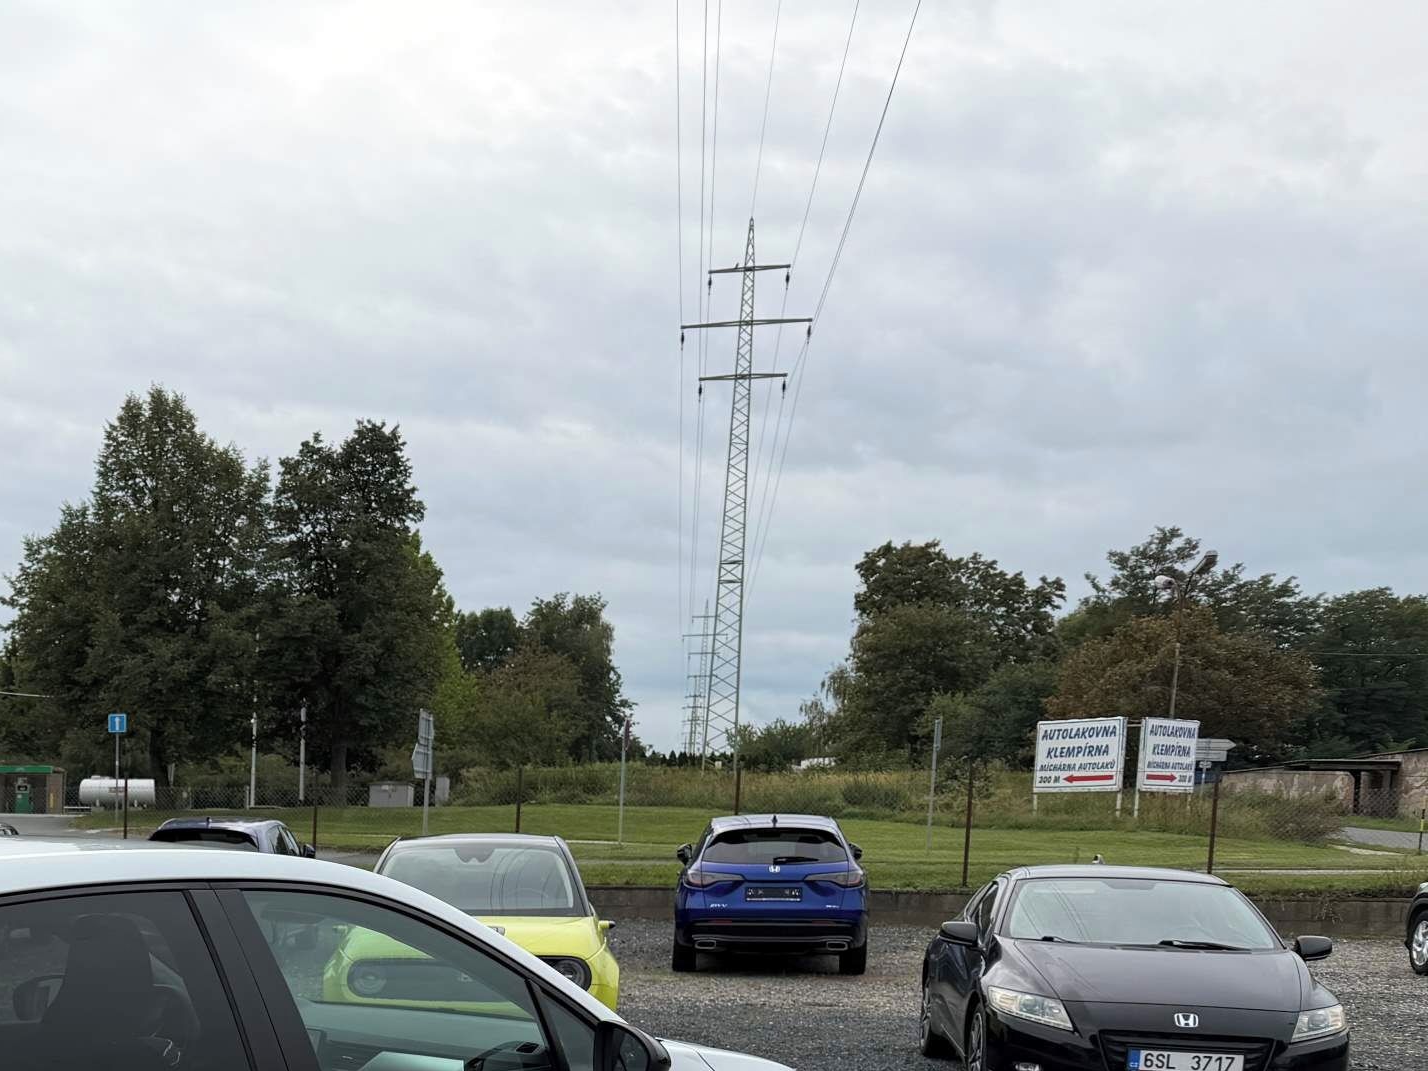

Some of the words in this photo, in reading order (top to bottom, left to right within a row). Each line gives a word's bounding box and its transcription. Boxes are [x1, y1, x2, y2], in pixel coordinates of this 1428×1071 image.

[1041, 724, 1117, 741] AUTOLAKOVNA
[1149, 723, 1197, 739] AUTOLAKOVNA
[1046, 741, 1110, 759] KLEMPÍRNA
[1152, 741, 1192, 758] KLEMPÍRNA
[1144, 1053, 1176, 1070] 6SL
[1190, 1055, 1236, 1071] 3717
